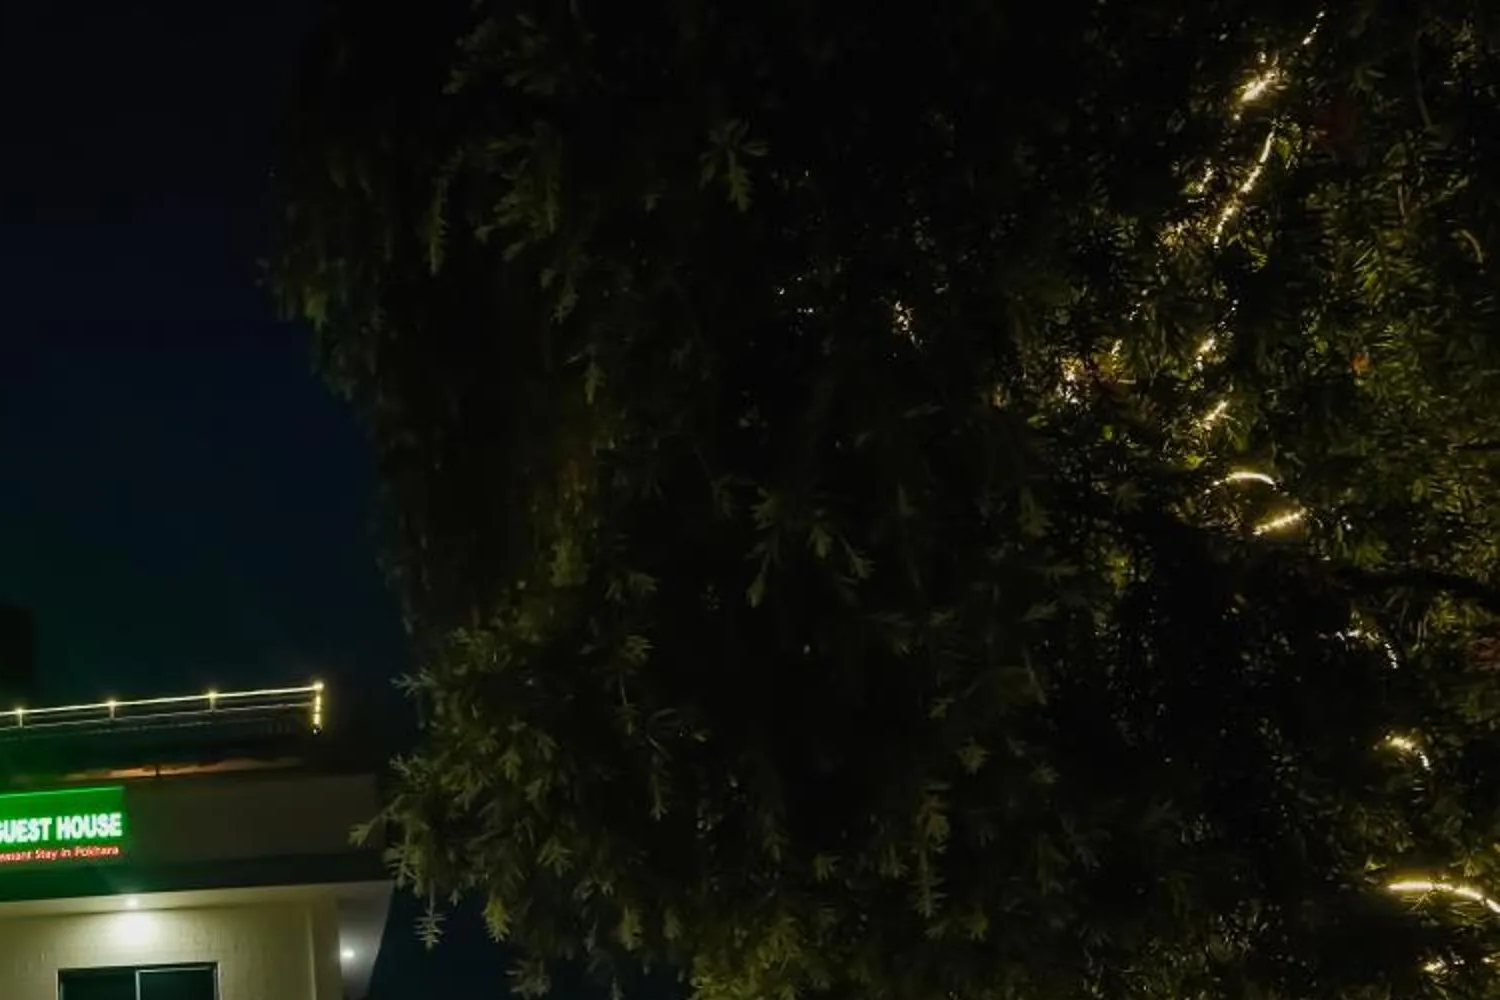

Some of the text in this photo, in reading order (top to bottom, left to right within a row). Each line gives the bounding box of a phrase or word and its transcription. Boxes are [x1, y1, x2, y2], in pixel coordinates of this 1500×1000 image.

[56, 812, 123, 840] HOUSE
[35, 848, 58, 860] Stay
[60, 847, 71, 857] in
[74, 845, 119, 856] Pokhara
